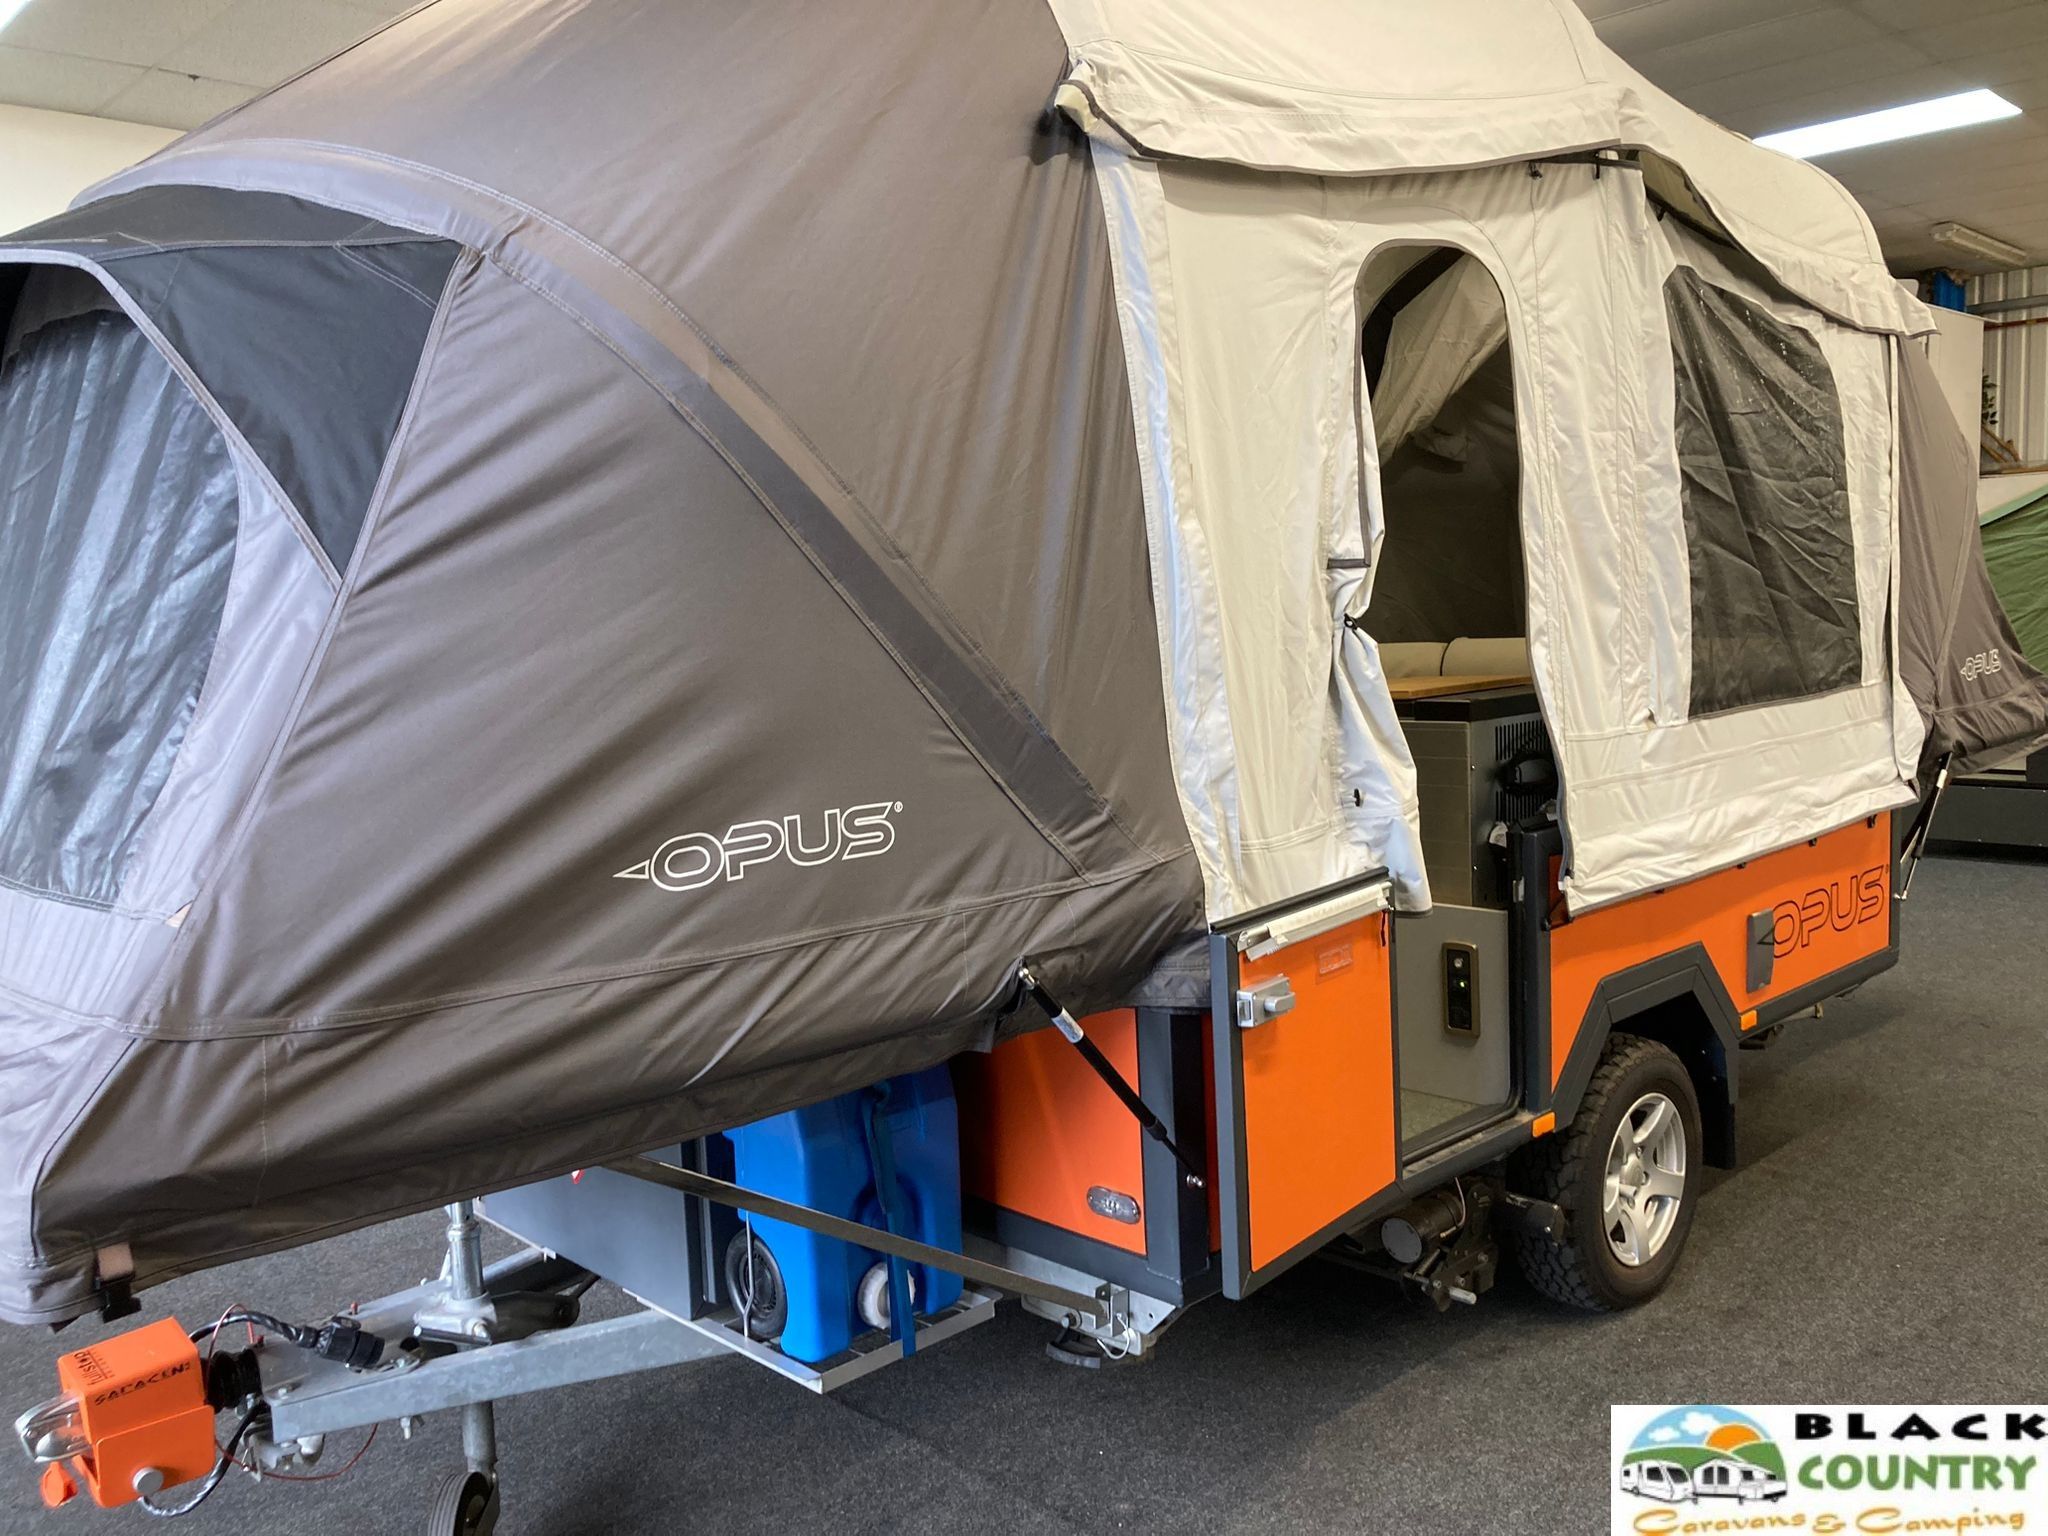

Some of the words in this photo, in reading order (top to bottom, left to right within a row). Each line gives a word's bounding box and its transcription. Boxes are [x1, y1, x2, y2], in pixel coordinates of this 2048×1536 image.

[1965, 648, 2002, 681] OPUS
[650, 801, 896, 892] OPUS
[1773, 864, 1886, 959] OPUS
